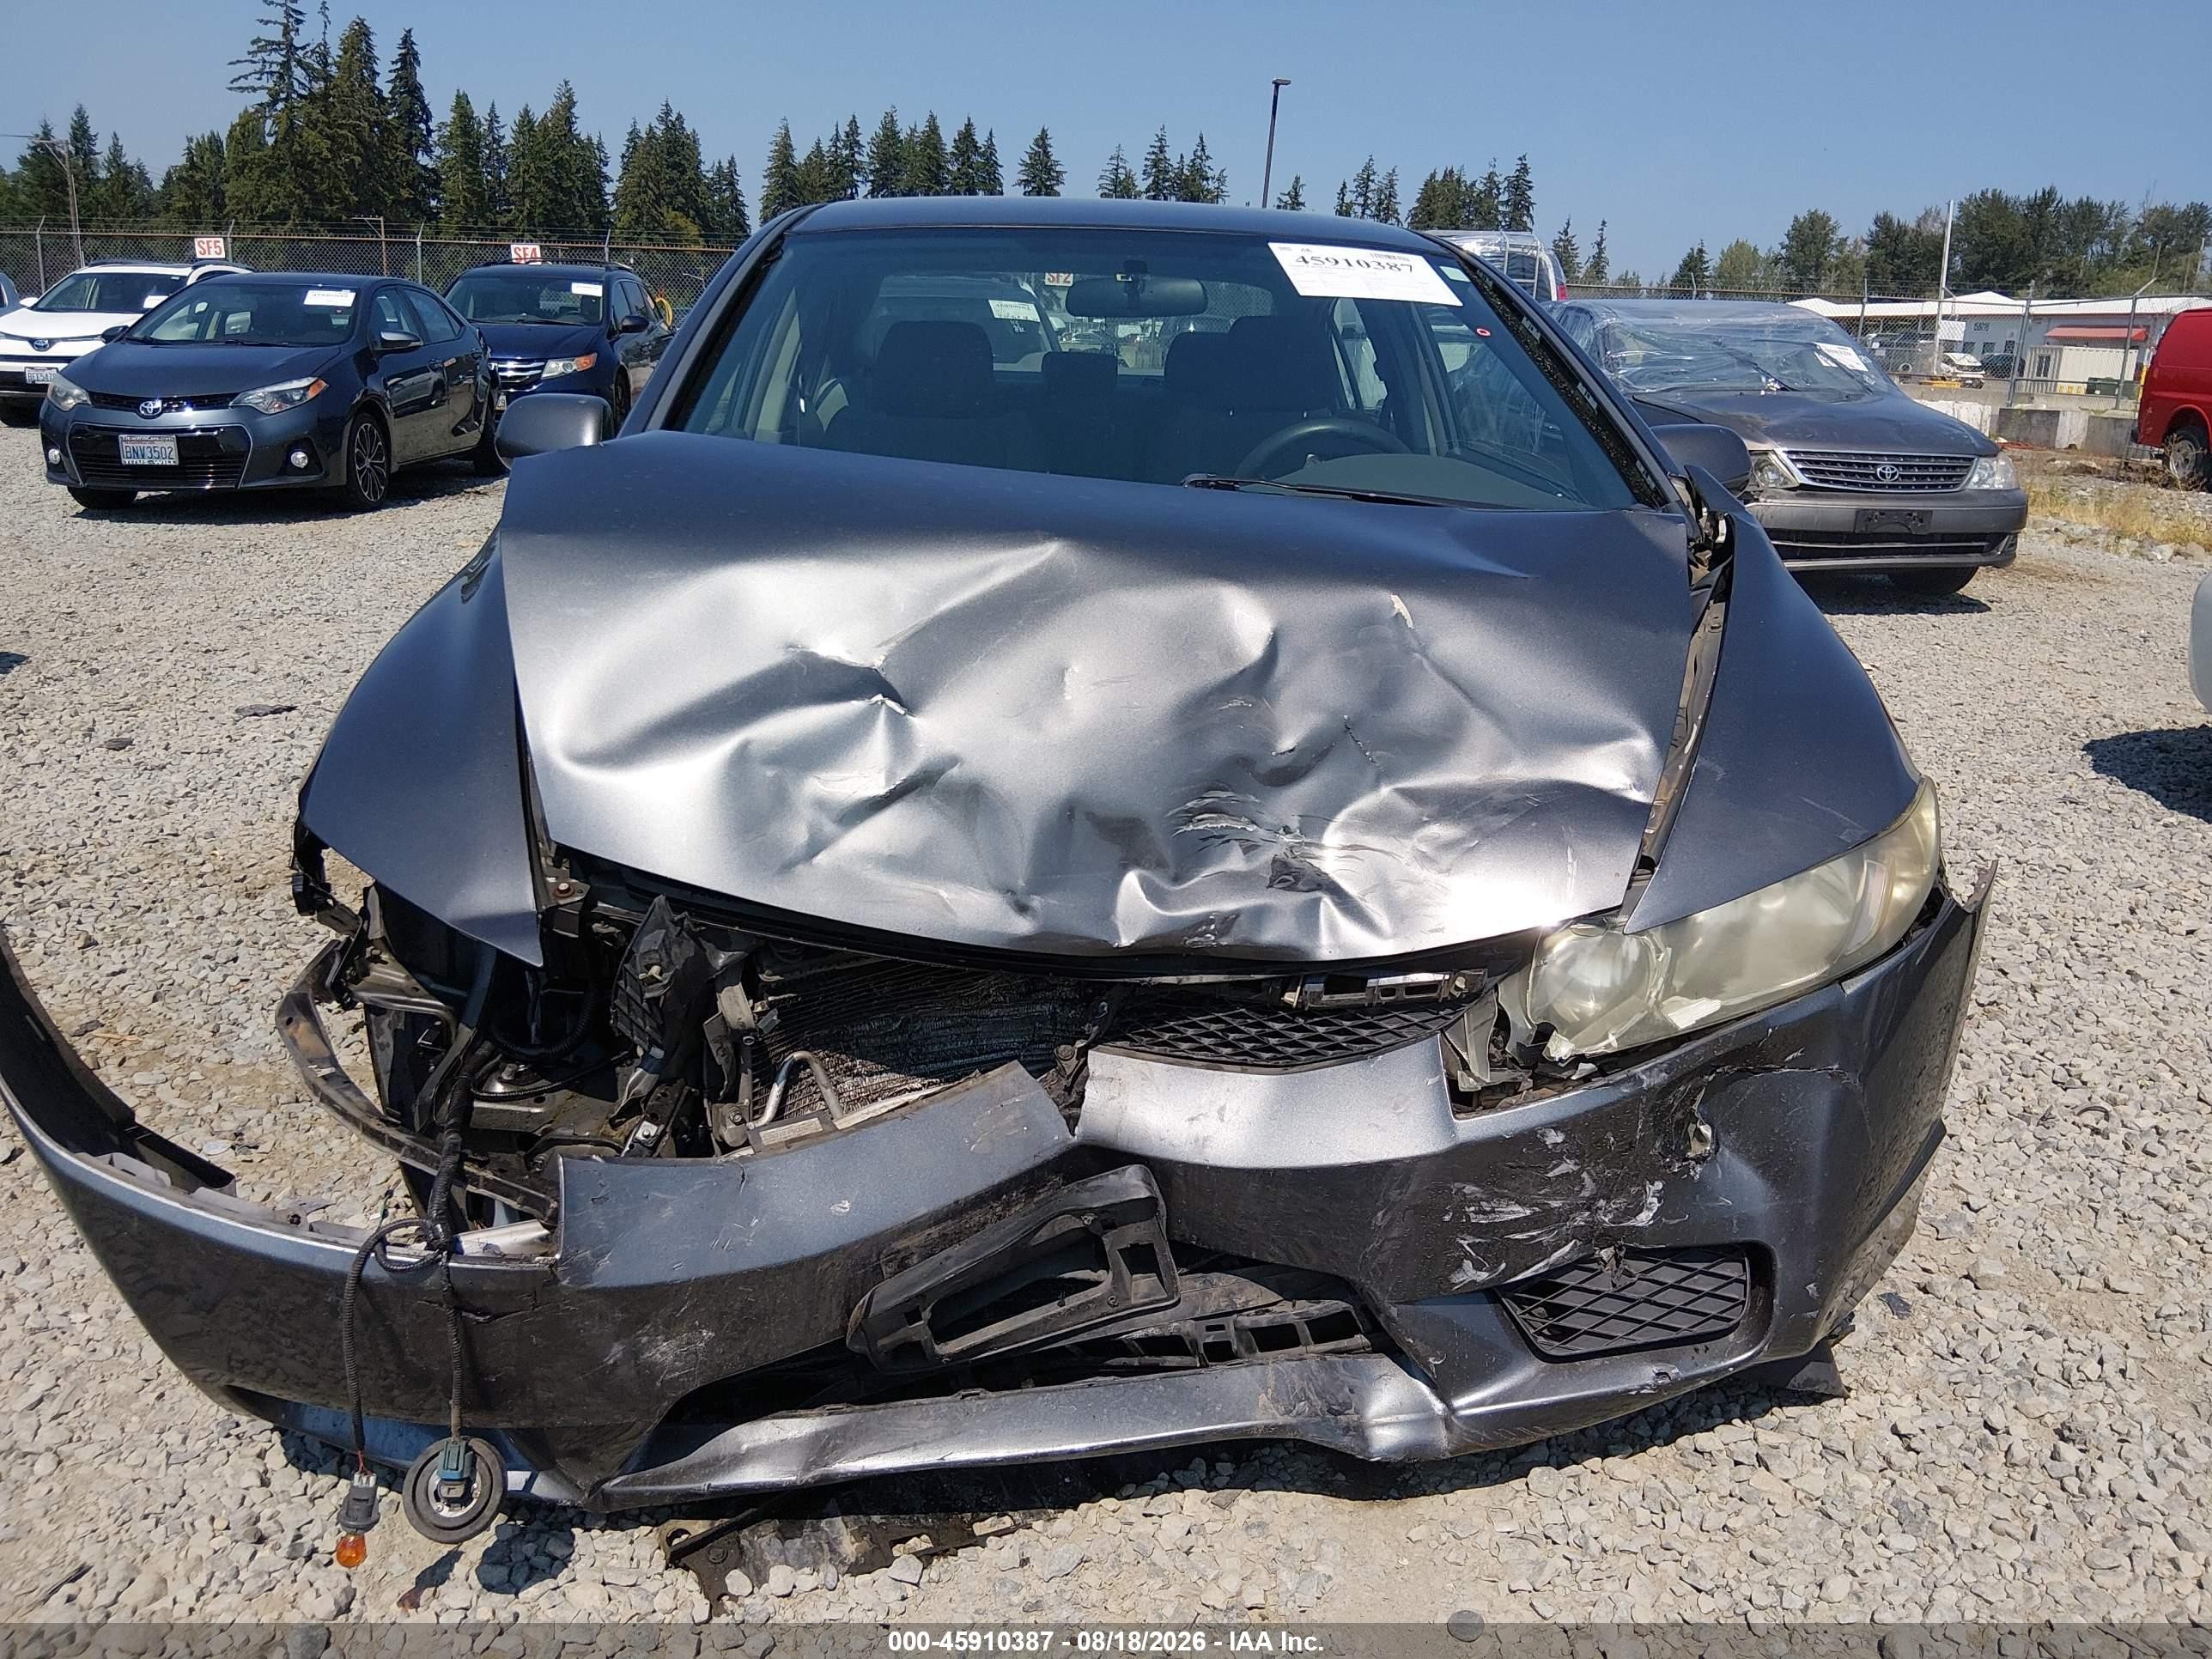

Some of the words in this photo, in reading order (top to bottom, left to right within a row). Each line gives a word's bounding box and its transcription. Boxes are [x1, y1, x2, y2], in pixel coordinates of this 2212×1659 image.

[198, 240, 222, 256] SF5
[514, 246, 538, 262] SF4
[1295, 255, 1413, 273] 45910387
[125, 445, 174, 460] BNV3502
